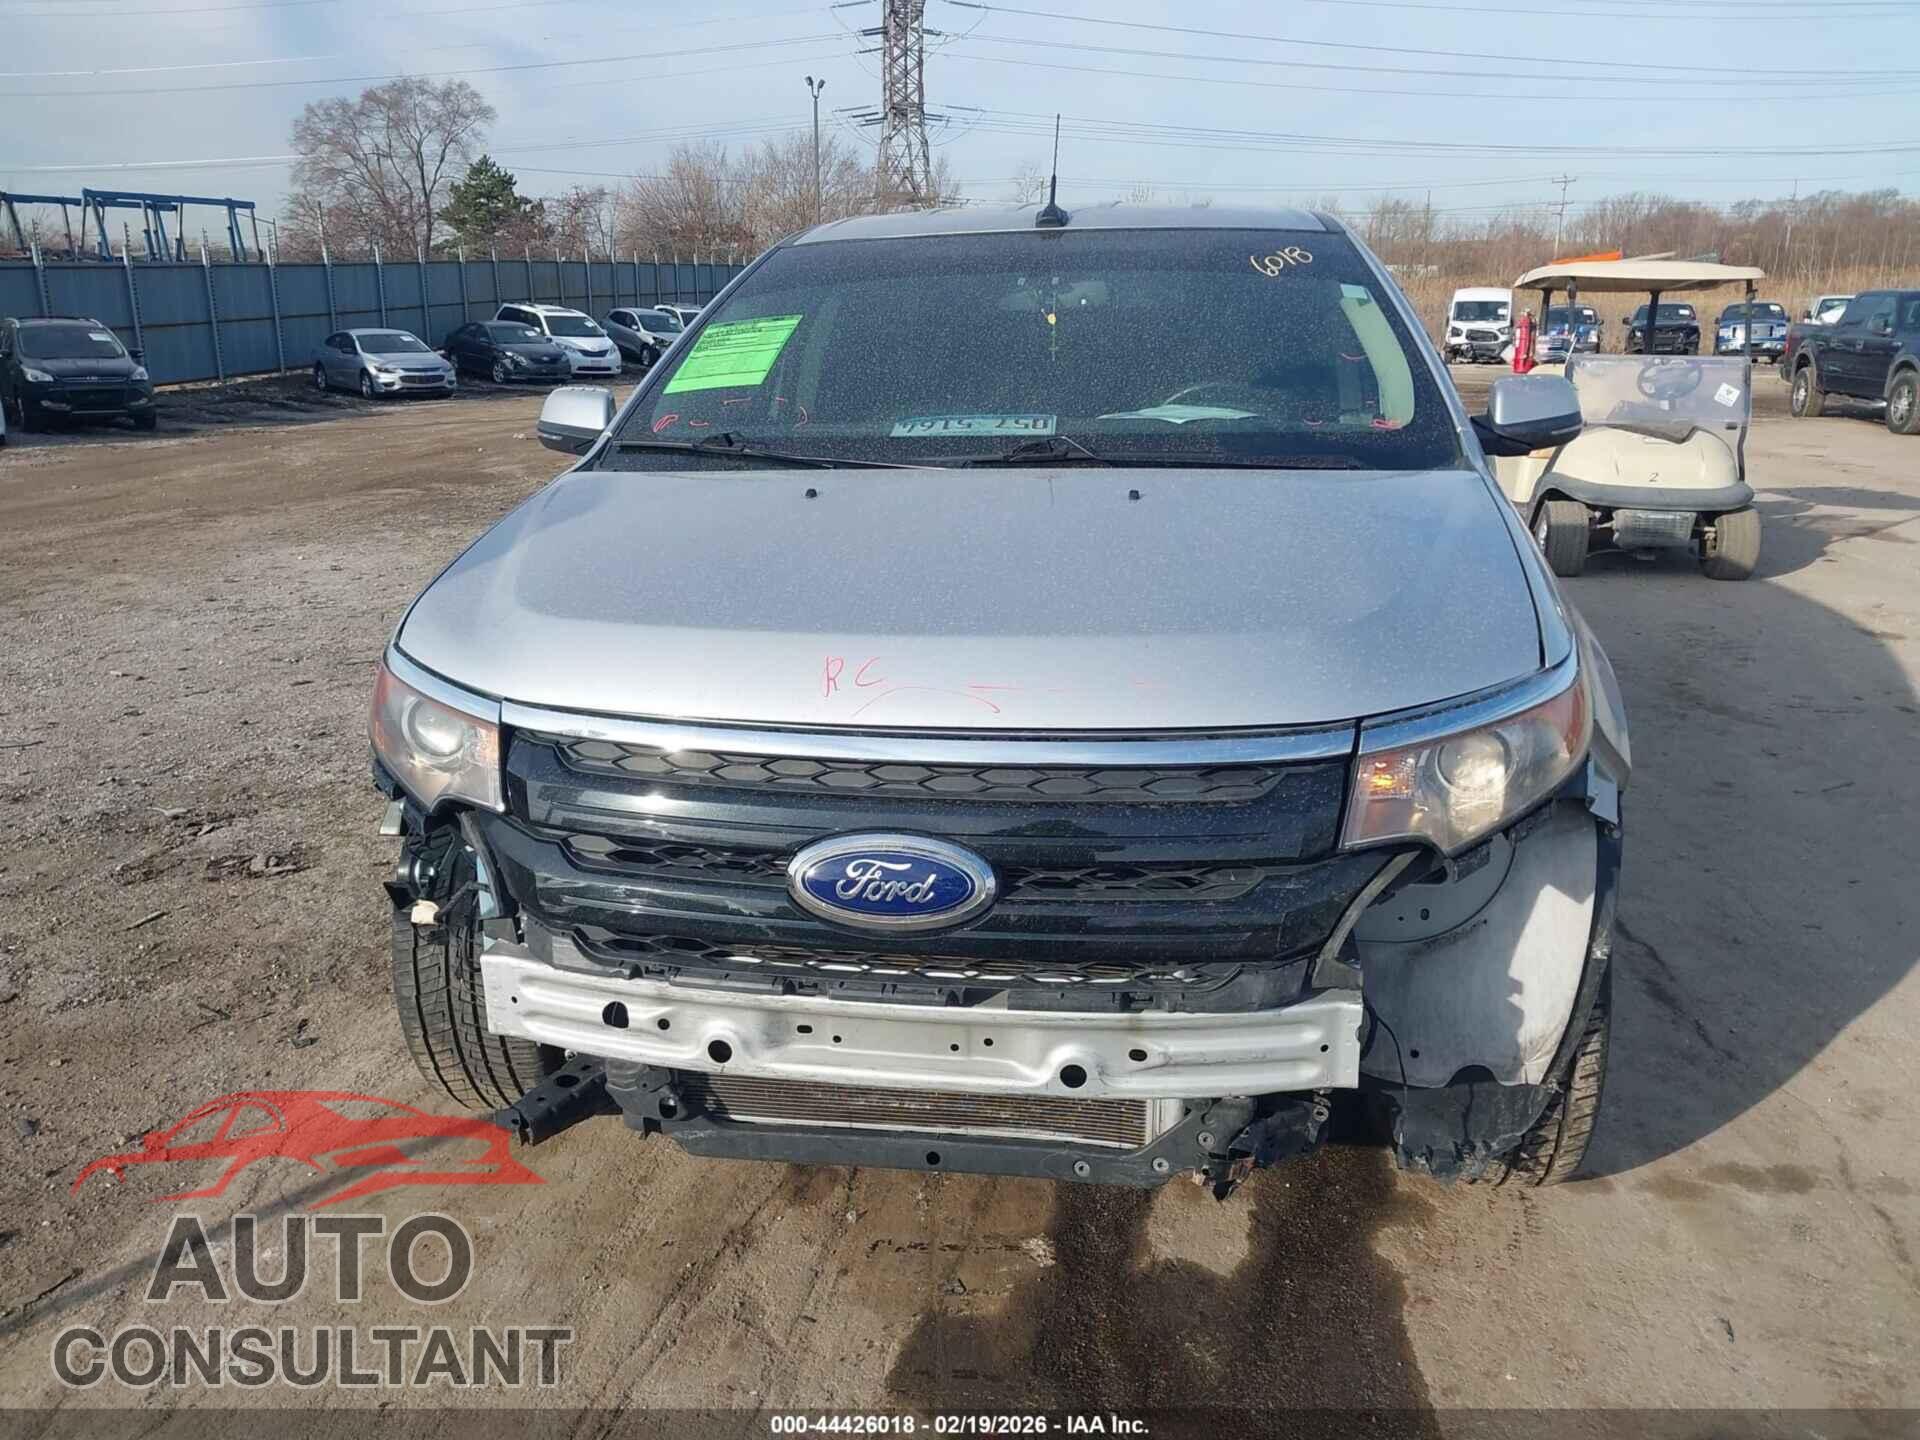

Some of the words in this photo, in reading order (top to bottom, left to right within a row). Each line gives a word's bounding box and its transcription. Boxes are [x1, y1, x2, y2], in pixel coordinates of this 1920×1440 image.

[1250, 246, 1313, 277] 6018
[1649, 472, 1659, 482] 2
[836, 859, 936, 903] Ford
